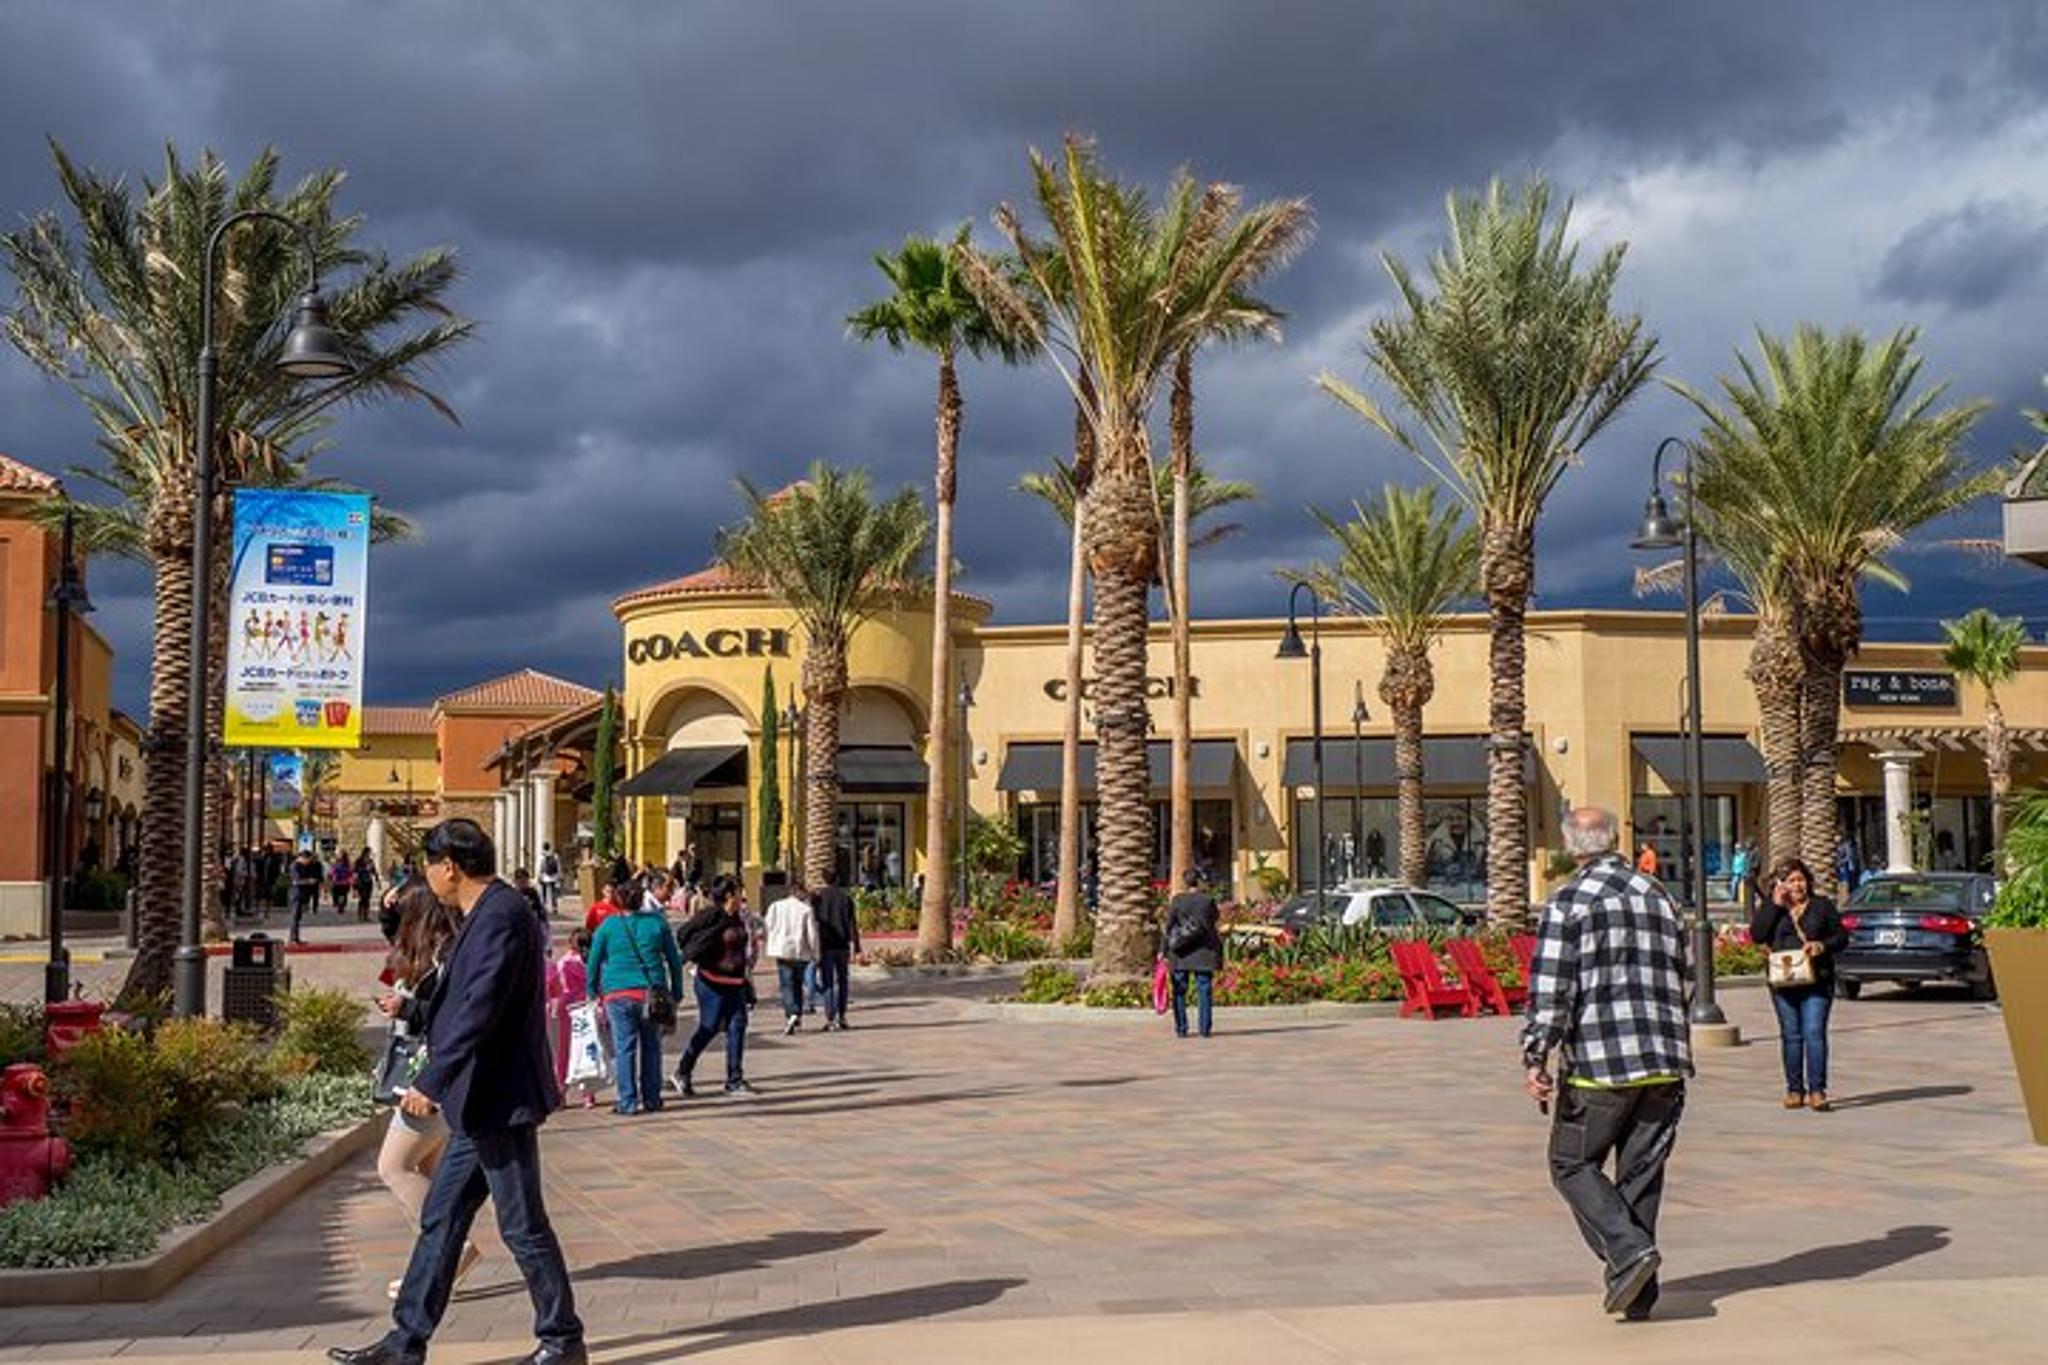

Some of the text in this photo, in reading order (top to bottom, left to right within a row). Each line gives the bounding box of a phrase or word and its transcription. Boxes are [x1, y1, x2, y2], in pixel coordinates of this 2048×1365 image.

[628, 628, 791, 666] COACH
[1850, 675, 1950, 691] rag & bone
